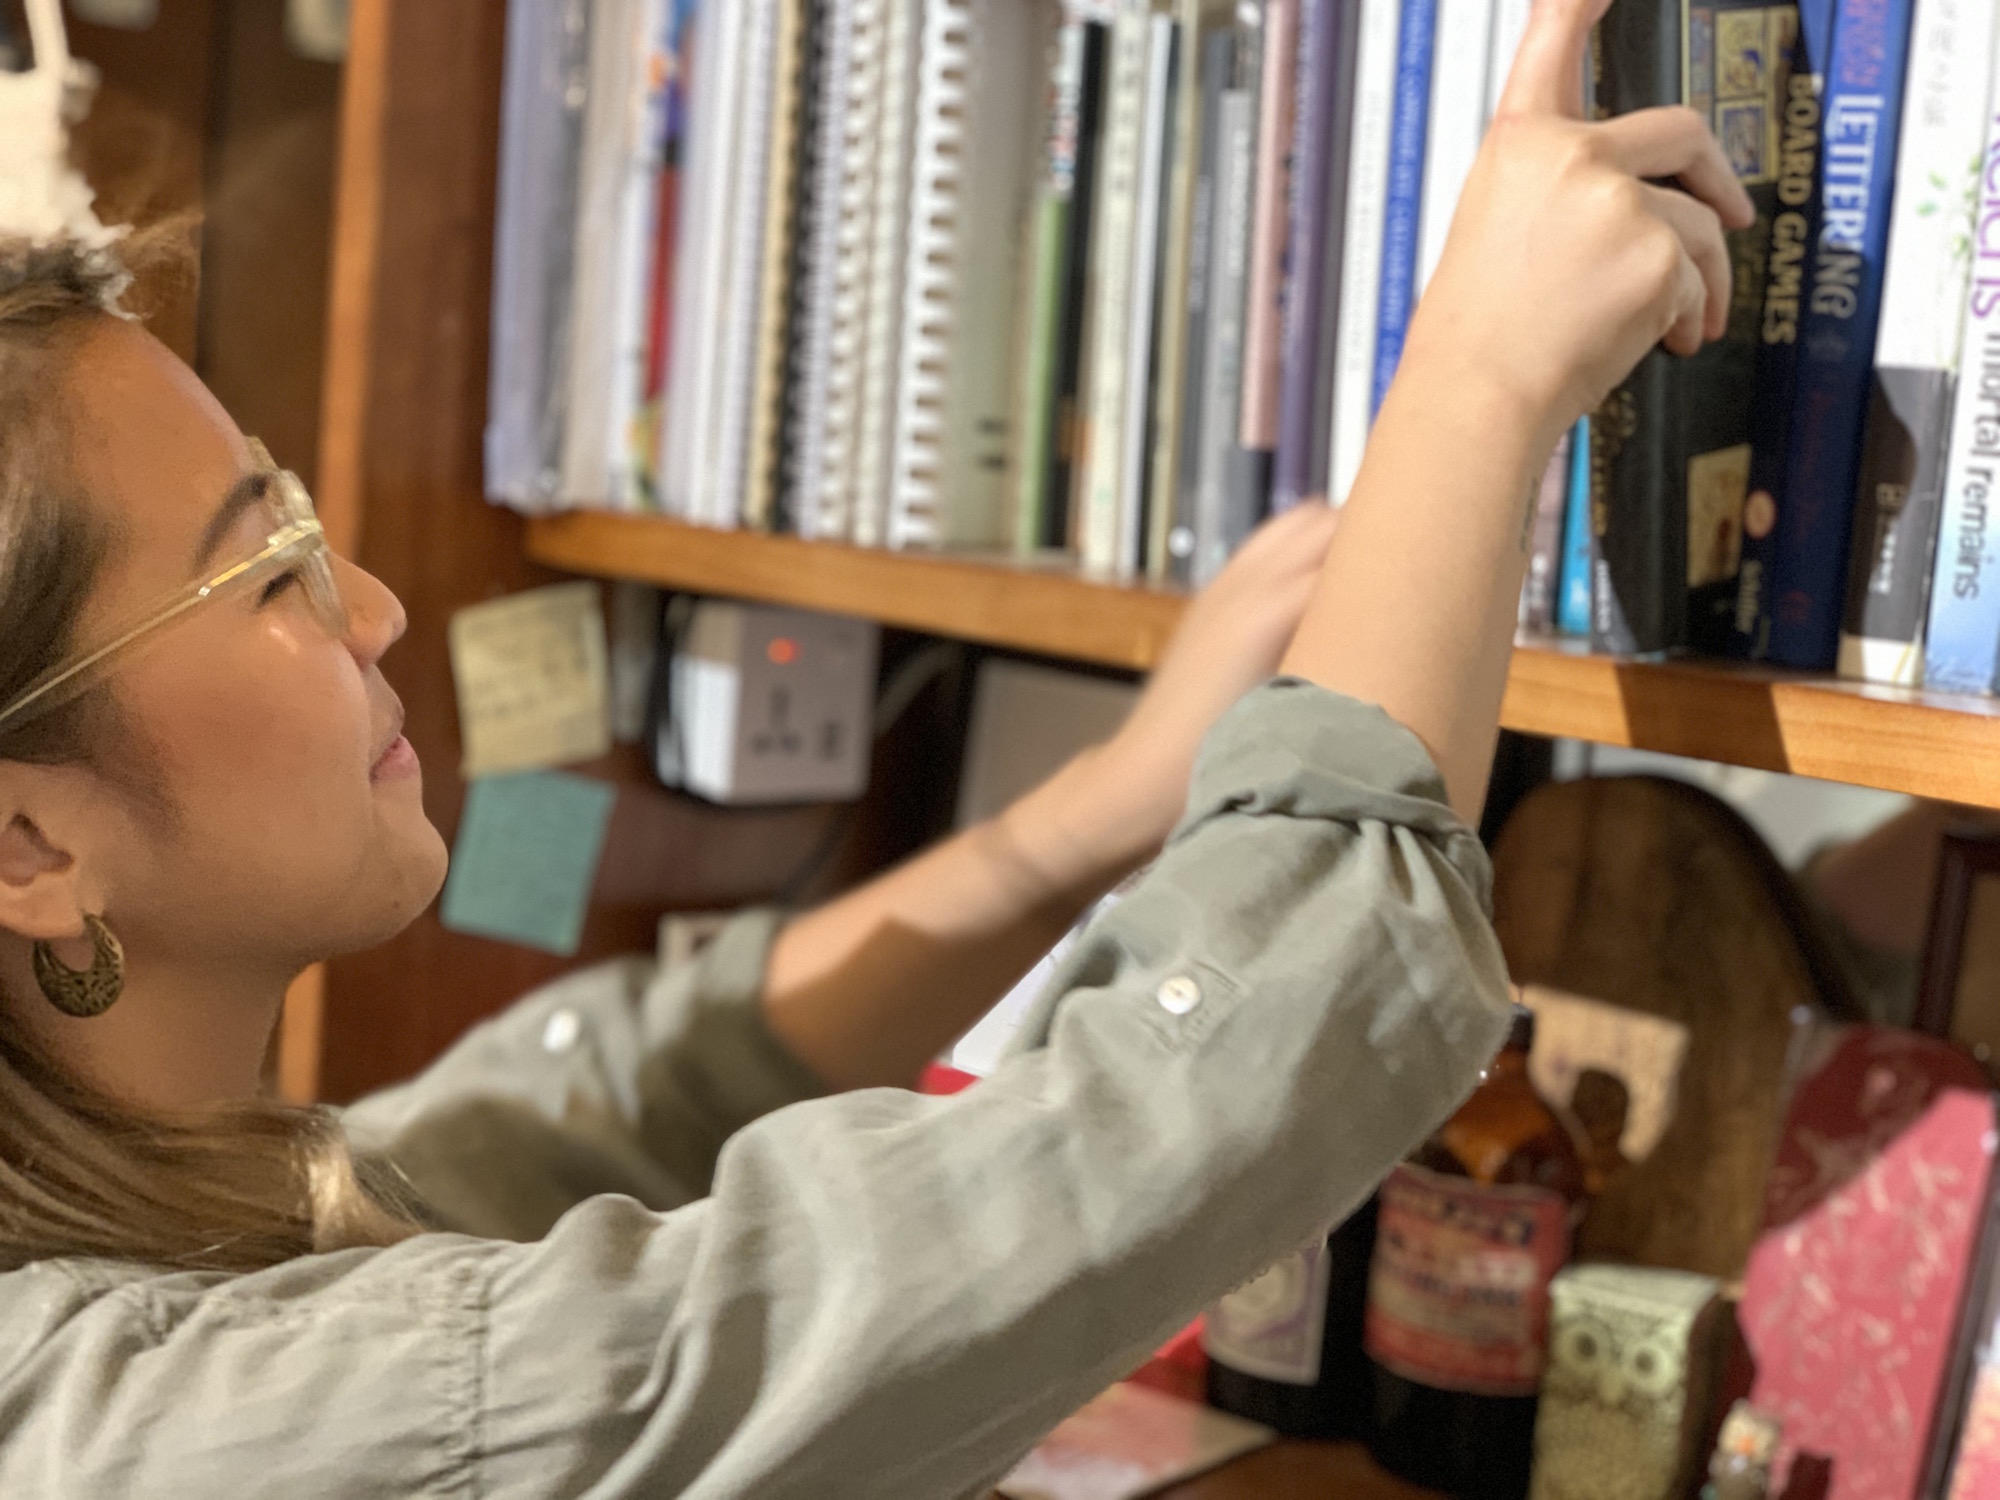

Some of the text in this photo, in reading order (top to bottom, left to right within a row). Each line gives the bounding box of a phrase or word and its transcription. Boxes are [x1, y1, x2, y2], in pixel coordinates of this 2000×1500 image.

[1762, 73, 1823, 344] BOARD GAMES
[1811, 95, 1884, 320] LETTERING
[1953, 467, 1996, 599] remains
